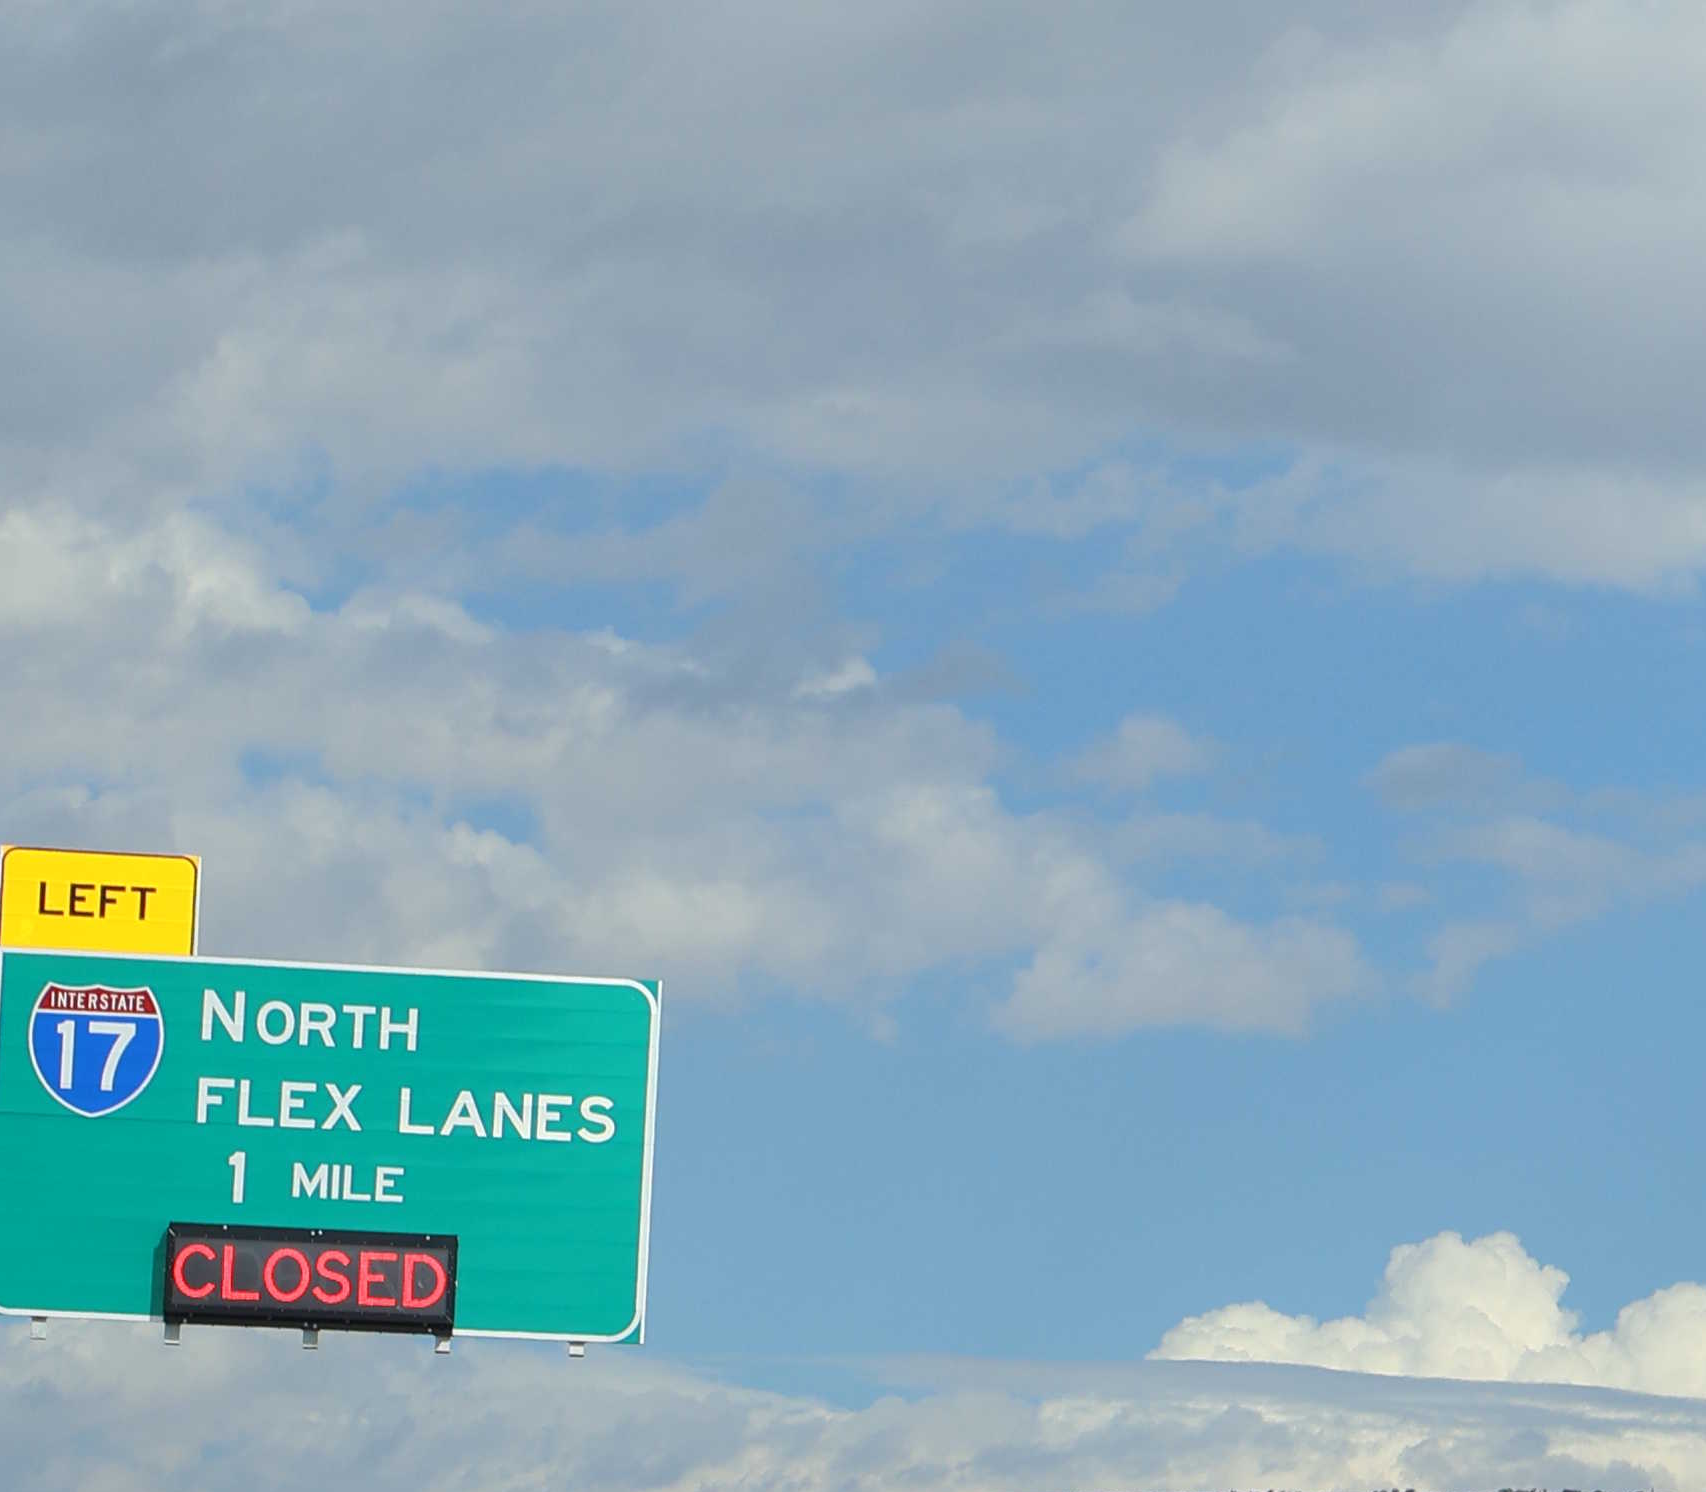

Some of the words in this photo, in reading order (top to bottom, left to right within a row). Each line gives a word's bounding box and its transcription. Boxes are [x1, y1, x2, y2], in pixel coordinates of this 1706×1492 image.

[39, 881, 157, 920] LEFT
[50, 991, 145, 1012] INTERSTATE
[200, 988, 419, 1052] NORTH
[57, 1019, 137, 1091] 17
[196, 1077, 363, 1132] FLEX
[399, 1086, 617, 1143] LANES
[228, 1151, 246, 1204] 1
[292, 1162, 405, 1203] MILE
[172, 1243, 448, 1309] CLOSED
